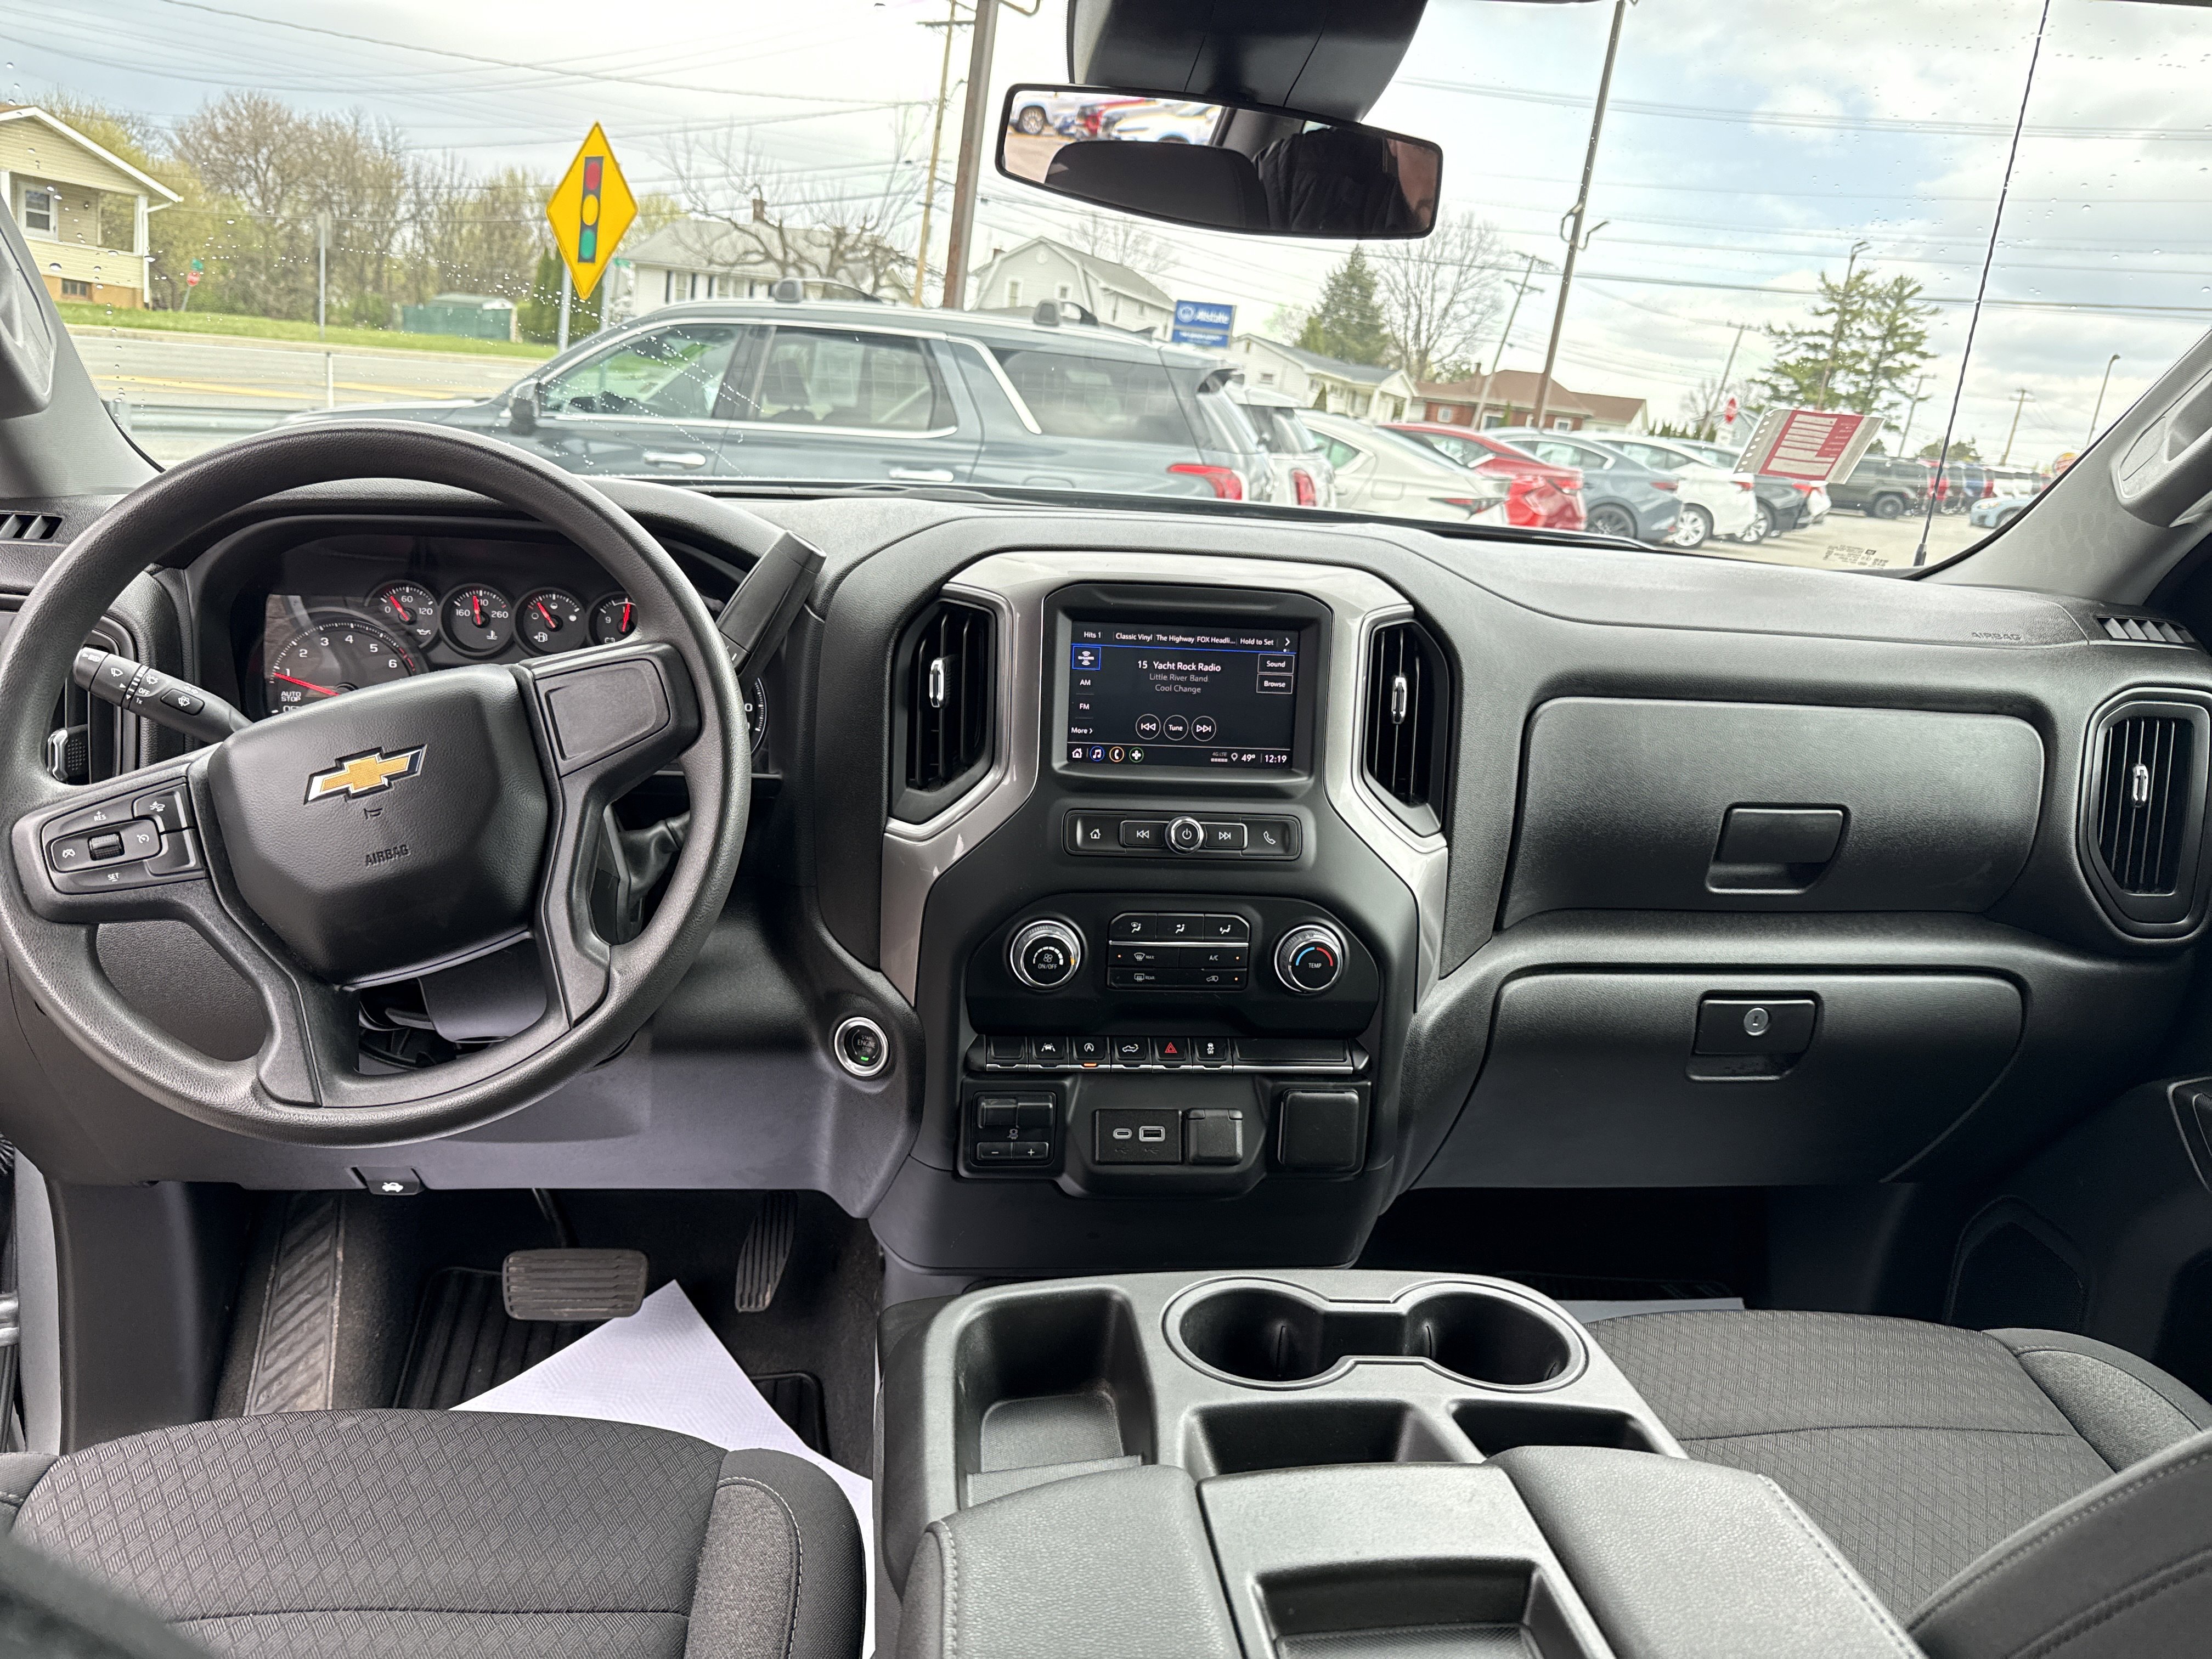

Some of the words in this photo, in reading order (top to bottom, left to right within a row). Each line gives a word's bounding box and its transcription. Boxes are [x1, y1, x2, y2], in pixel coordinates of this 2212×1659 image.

[491, 611, 509, 619] 260
[345, 635, 354, 644] 4
[1138, 634, 1153, 642] Vinyl
[1169, 635, 1195, 644] Highway
[1972, 632, 2021, 641] AIRBAG
[320, 637, 329, 646] 3
[299, 649, 308, 657] 2
[370, 644, 378, 653] 5
[388, 659, 397, 668] 6
[1138, 661, 1148, 669] 15
[1153, 661, 1176, 670] Yacht
[1177, 662, 1197, 670] Rock
[1198, 663, 1221, 672] Radio
[285, 668, 290, 676] 1
[138, 687, 150, 696] OFF
[1173, 685, 1201, 695] Change
[1265, 754, 1287, 763] 12:19
[365, 844, 410, 867] AIRBAG
[857, 1039, 876, 1048] ENGINE
